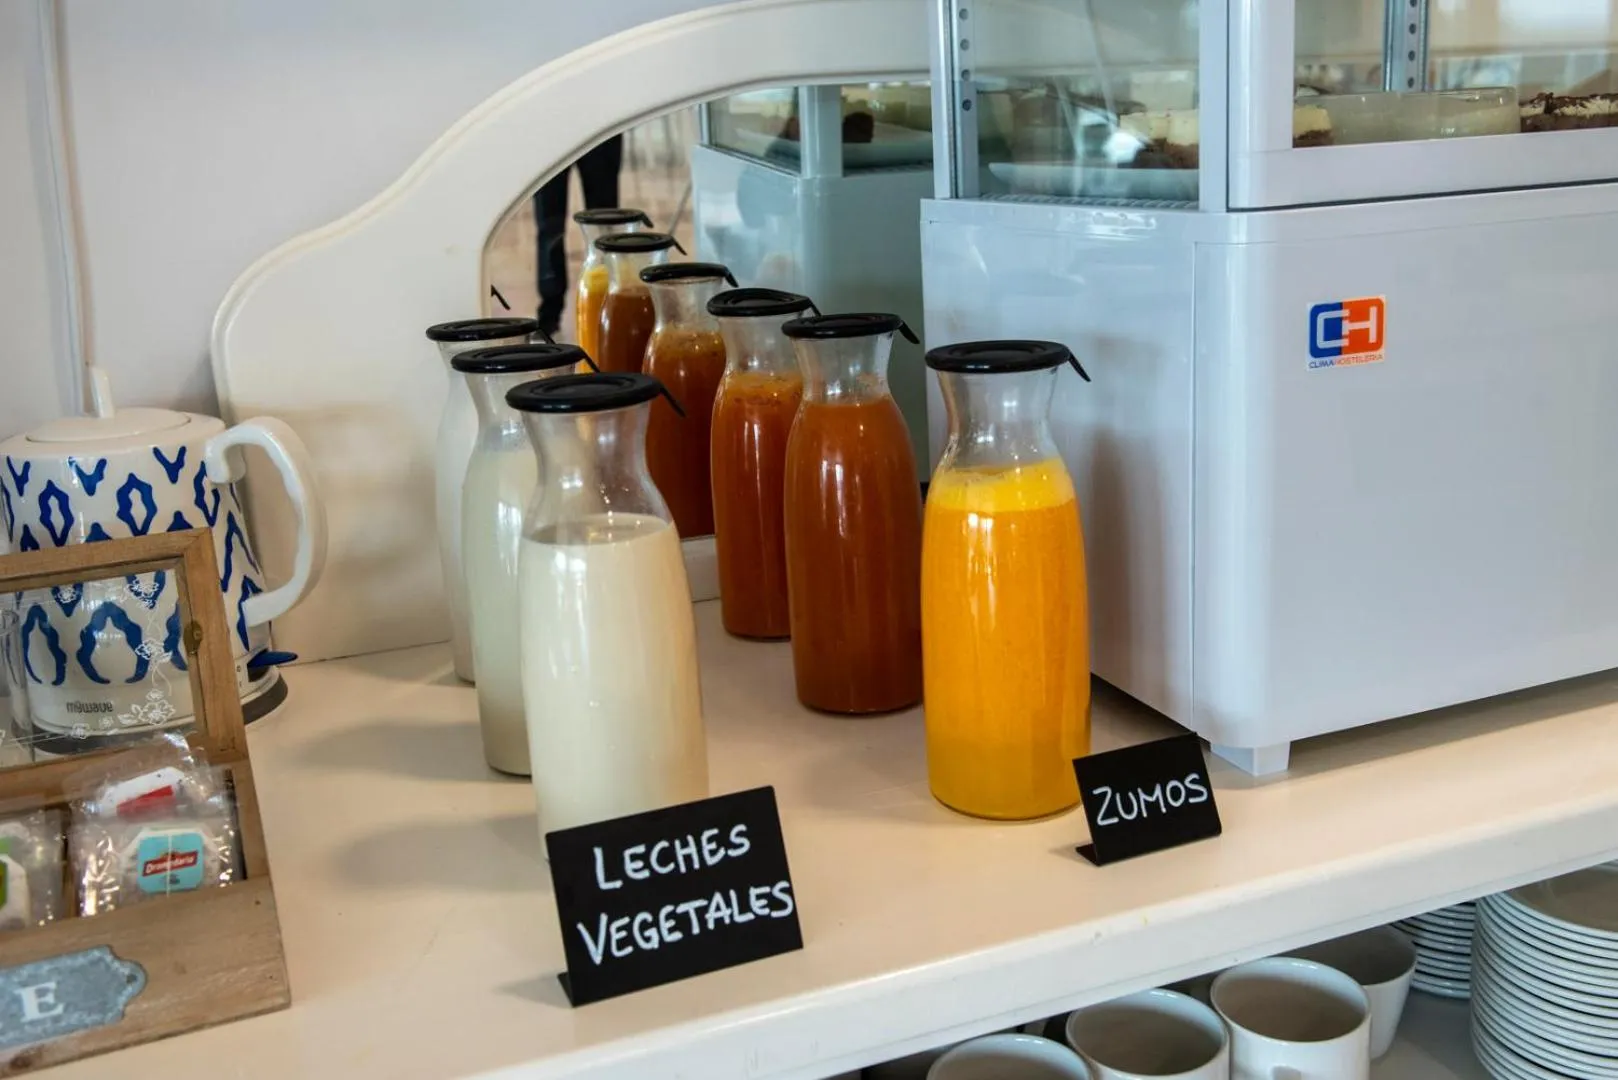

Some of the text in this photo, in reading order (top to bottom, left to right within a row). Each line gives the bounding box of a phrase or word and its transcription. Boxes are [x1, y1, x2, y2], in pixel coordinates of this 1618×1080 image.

[1092, 772, 1208, 826] ZUMOS
[593, 823, 751, 890] LECHES
[577, 880, 794, 965] VEGETALES
[13, 981, 65, 1022] E
